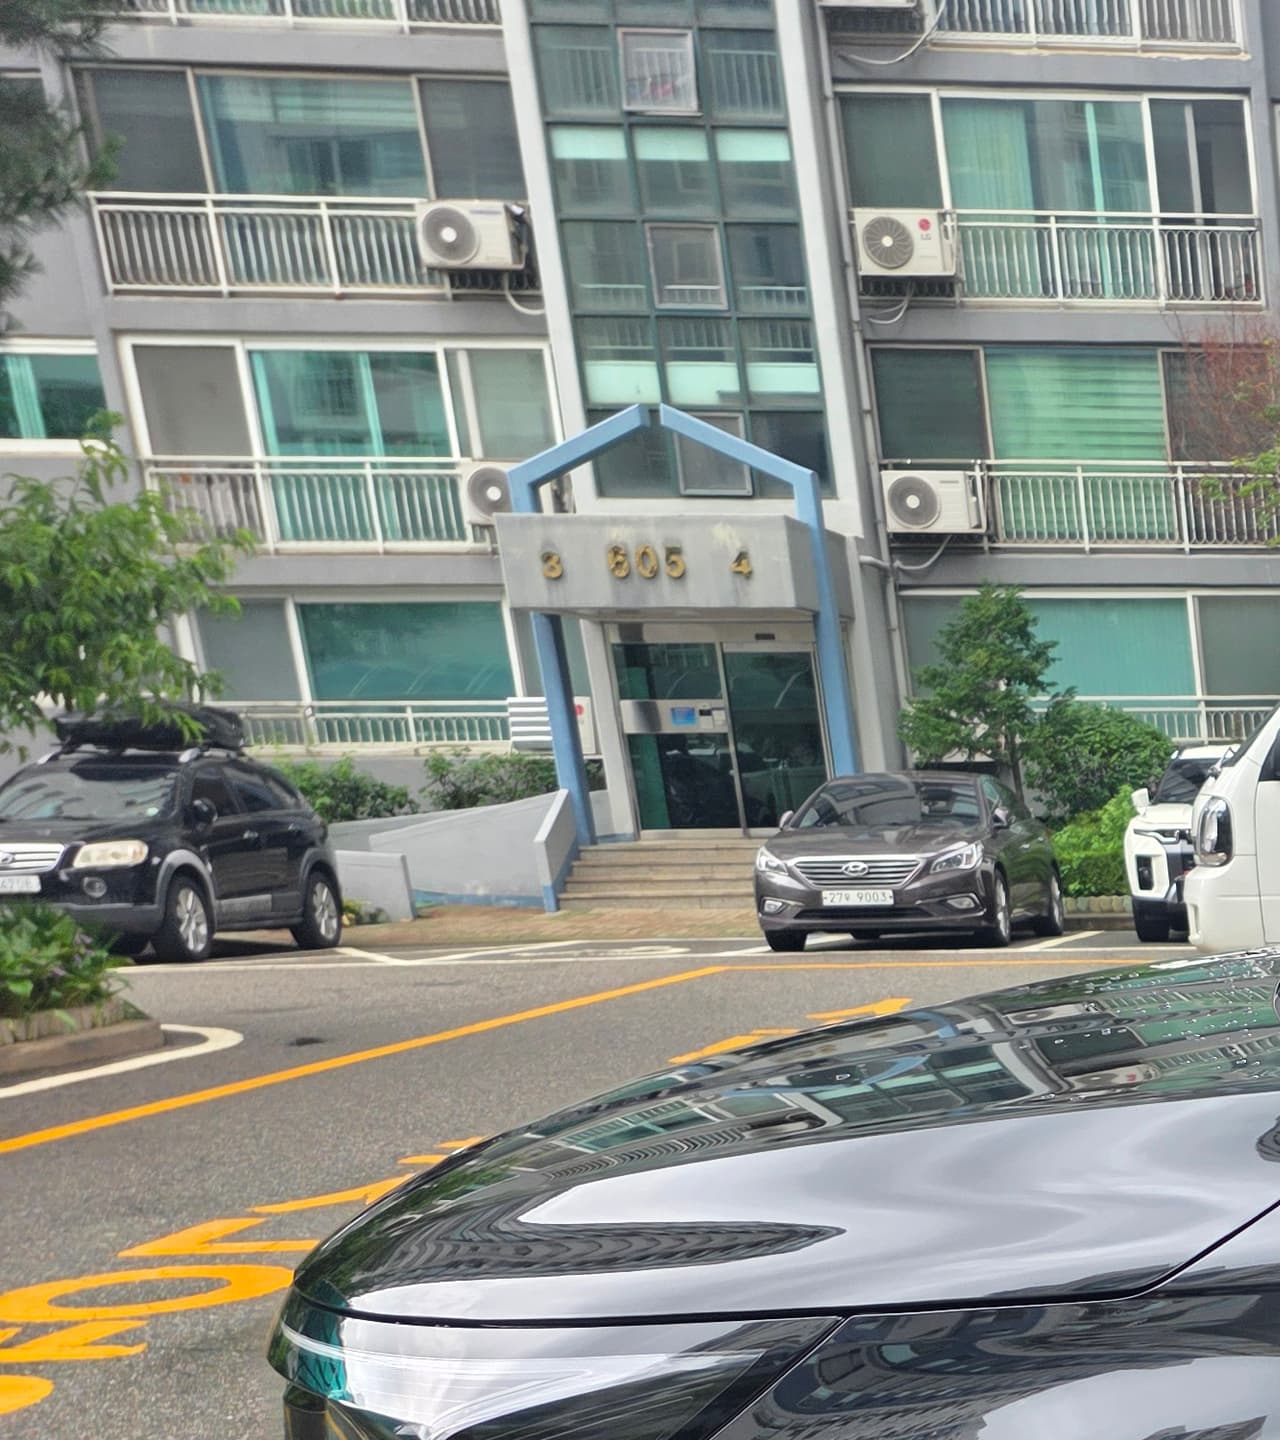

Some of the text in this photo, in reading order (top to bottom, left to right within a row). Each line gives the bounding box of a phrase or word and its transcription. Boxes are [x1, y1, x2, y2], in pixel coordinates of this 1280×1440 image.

[541, 545, 753, 580] 3 605 4
[857, 890, 888, 903] 9003
